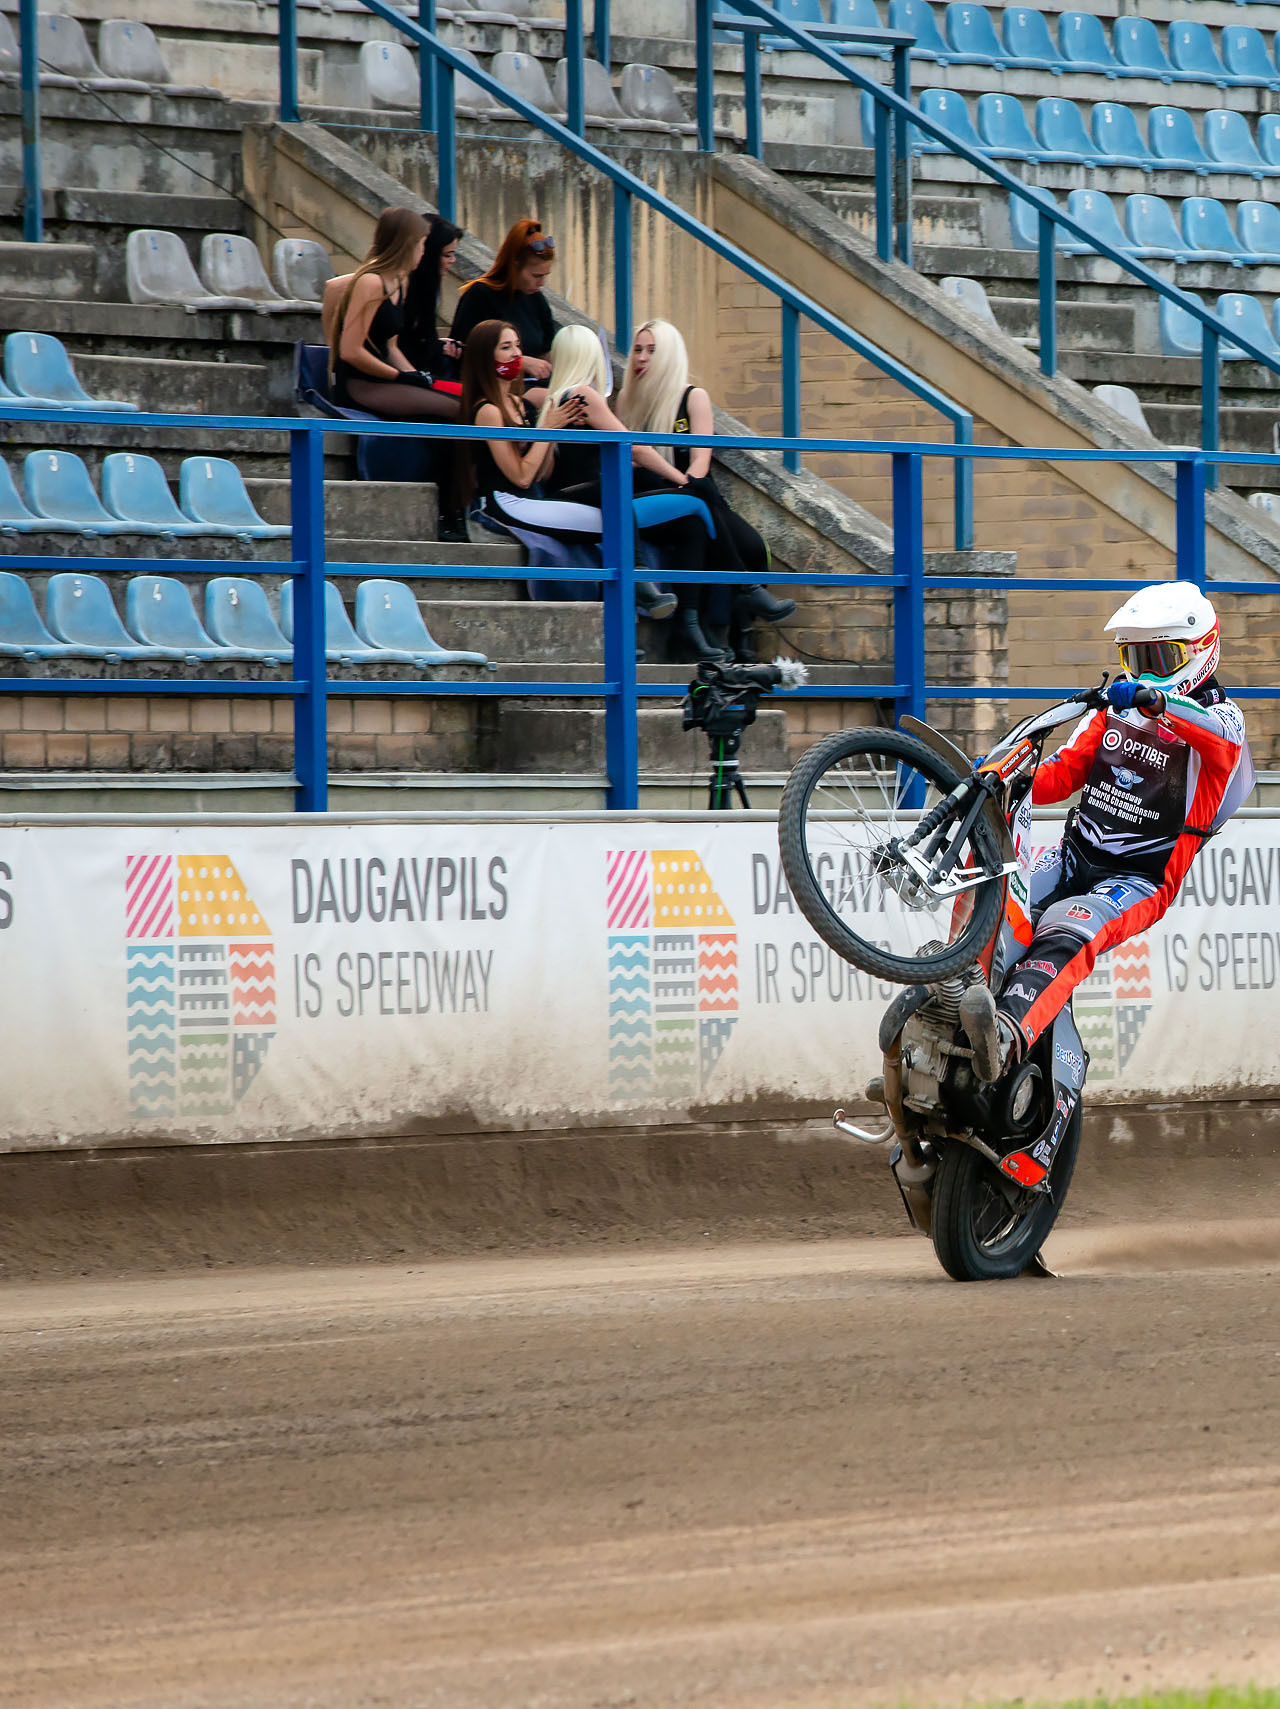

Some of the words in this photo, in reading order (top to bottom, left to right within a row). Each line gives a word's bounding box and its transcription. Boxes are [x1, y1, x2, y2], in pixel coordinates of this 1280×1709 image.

[1123, 738, 1170, 767] OPTIBET
[1087, 796, 1117, 815] Qualifying
[1117, 809, 1138, 823] Round
[1138, 817, 1142, 825] 1
[1091, 786, 1110, 802] World
[1110, 796, 1160, 820] Championship
[1099, 781, 1111, 791] FIM
[1111, 784, 1143, 805] Speedway
[290, 856, 508, 924] DAUGAVPILS
[294, 952, 321, 1019] IS
[336, 948, 494, 1016] SPEEDWAY
[755, 943, 780, 1003] IR
[1164, 933, 1189, 992] IS
